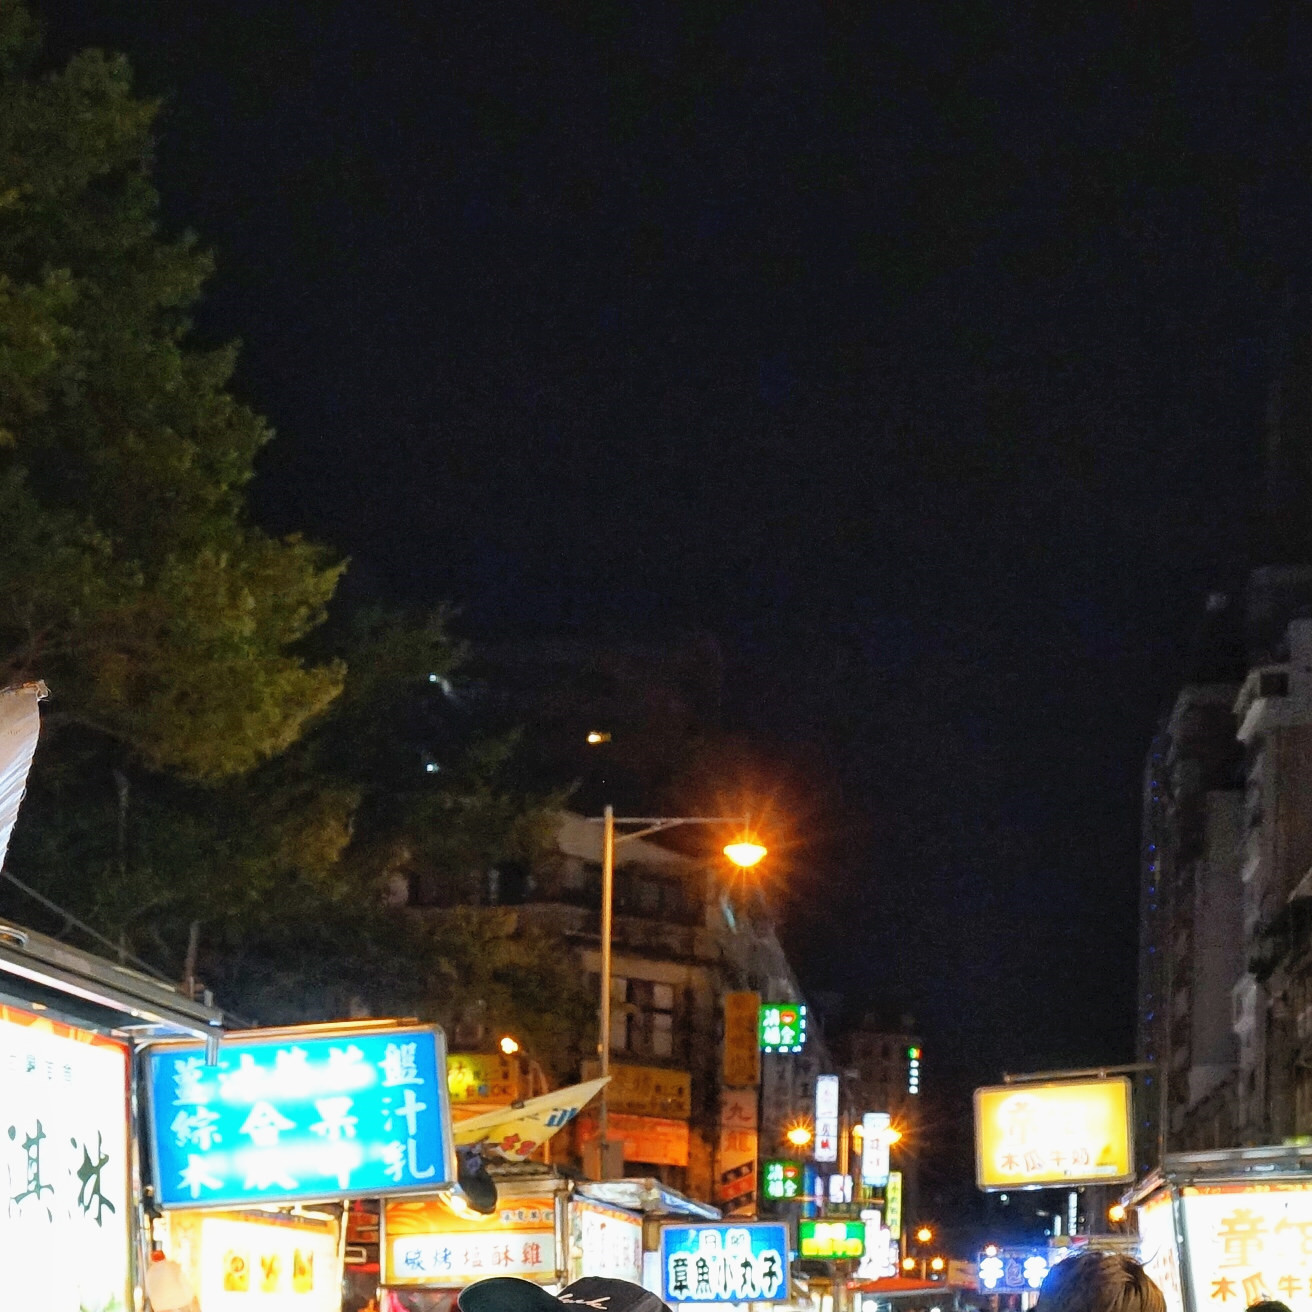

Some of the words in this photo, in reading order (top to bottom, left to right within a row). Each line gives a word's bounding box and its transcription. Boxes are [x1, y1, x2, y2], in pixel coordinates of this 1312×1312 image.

[172, 1090, 426, 1150] 綜合果汁
[672, 1255, 779, 1295] 章魚小丸子
